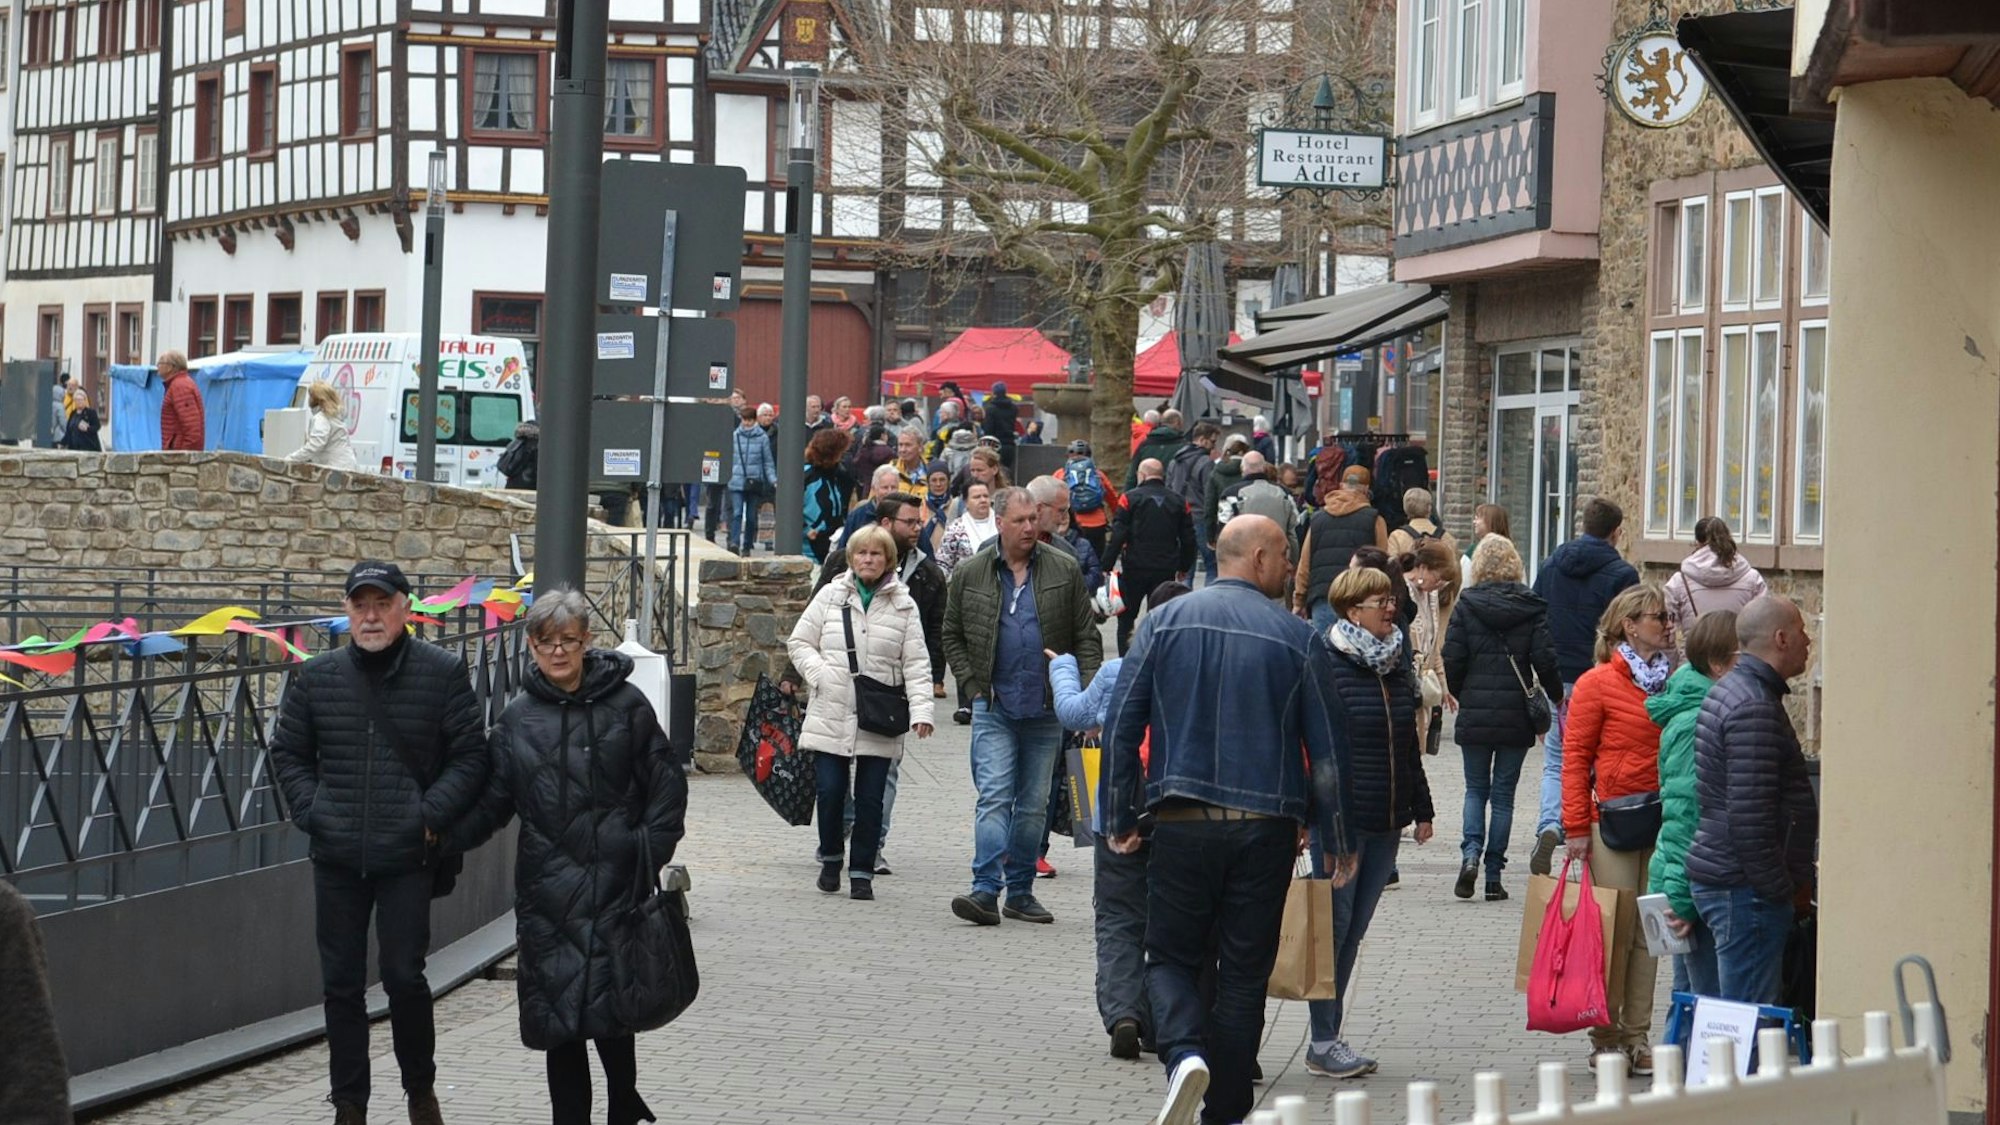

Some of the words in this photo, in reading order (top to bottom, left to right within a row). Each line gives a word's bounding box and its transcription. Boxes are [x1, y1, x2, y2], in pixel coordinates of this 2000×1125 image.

[1297, 136, 1349, 150] Hotel
[1272, 149, 1374, 165] Restaurant
[1294, 165, 1361, 183] Adler
[440, 341, 495, 355] TALIA
[438, 360, 487, 379] EIS
